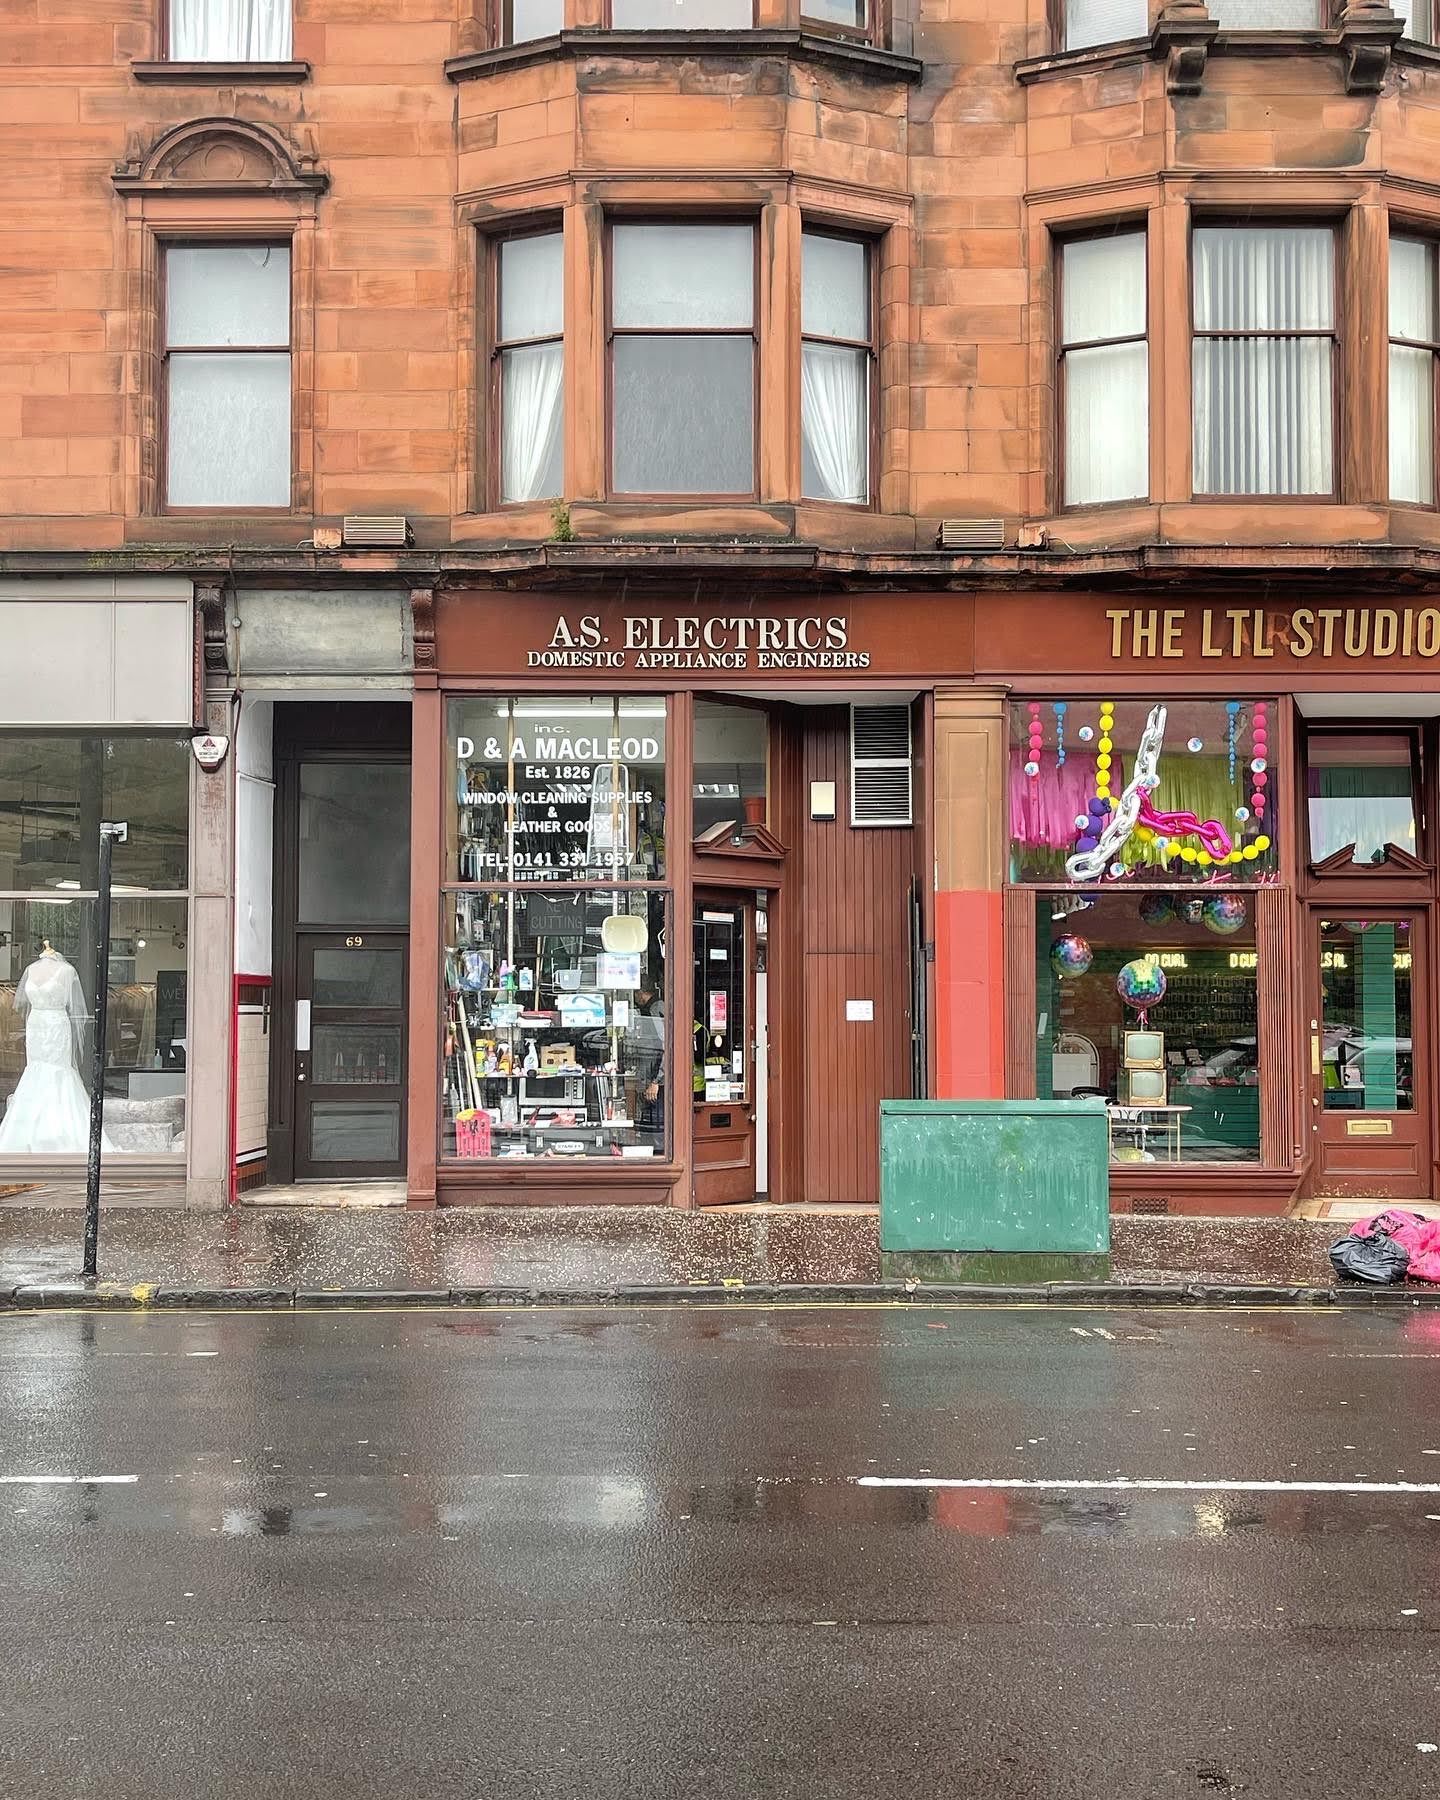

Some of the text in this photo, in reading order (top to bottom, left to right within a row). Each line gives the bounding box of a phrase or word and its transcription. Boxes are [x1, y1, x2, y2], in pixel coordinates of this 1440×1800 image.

[548, 616, 848, 650] A.S. ELECTRICS
[1106, 609, 1185, 657] THE
[1201, 609, 1274, 657] LTL
[1290, 608, 1440, 657] STUDIO
[527, 651, 870, 668] DOMESTIC APPLIANCE ENGINEERS
[534, 724, 571, 733] inc.
[457, 737, 659, 760] D & A MACLEOD
[525, 766, 591, 779] Est. 1826
[463, 791, 652, 804] WINDOW CLEANING SUPPLIES
[547, 806, 558, 818] &
[503, 820, 611, 833] LEATHER GOODS
[513, 853, 553, 867] 0141
[559, 853, 588, 867] 331
[531, 915, 583, 929] CUTTING
[346, 936, 362, 947] 69
